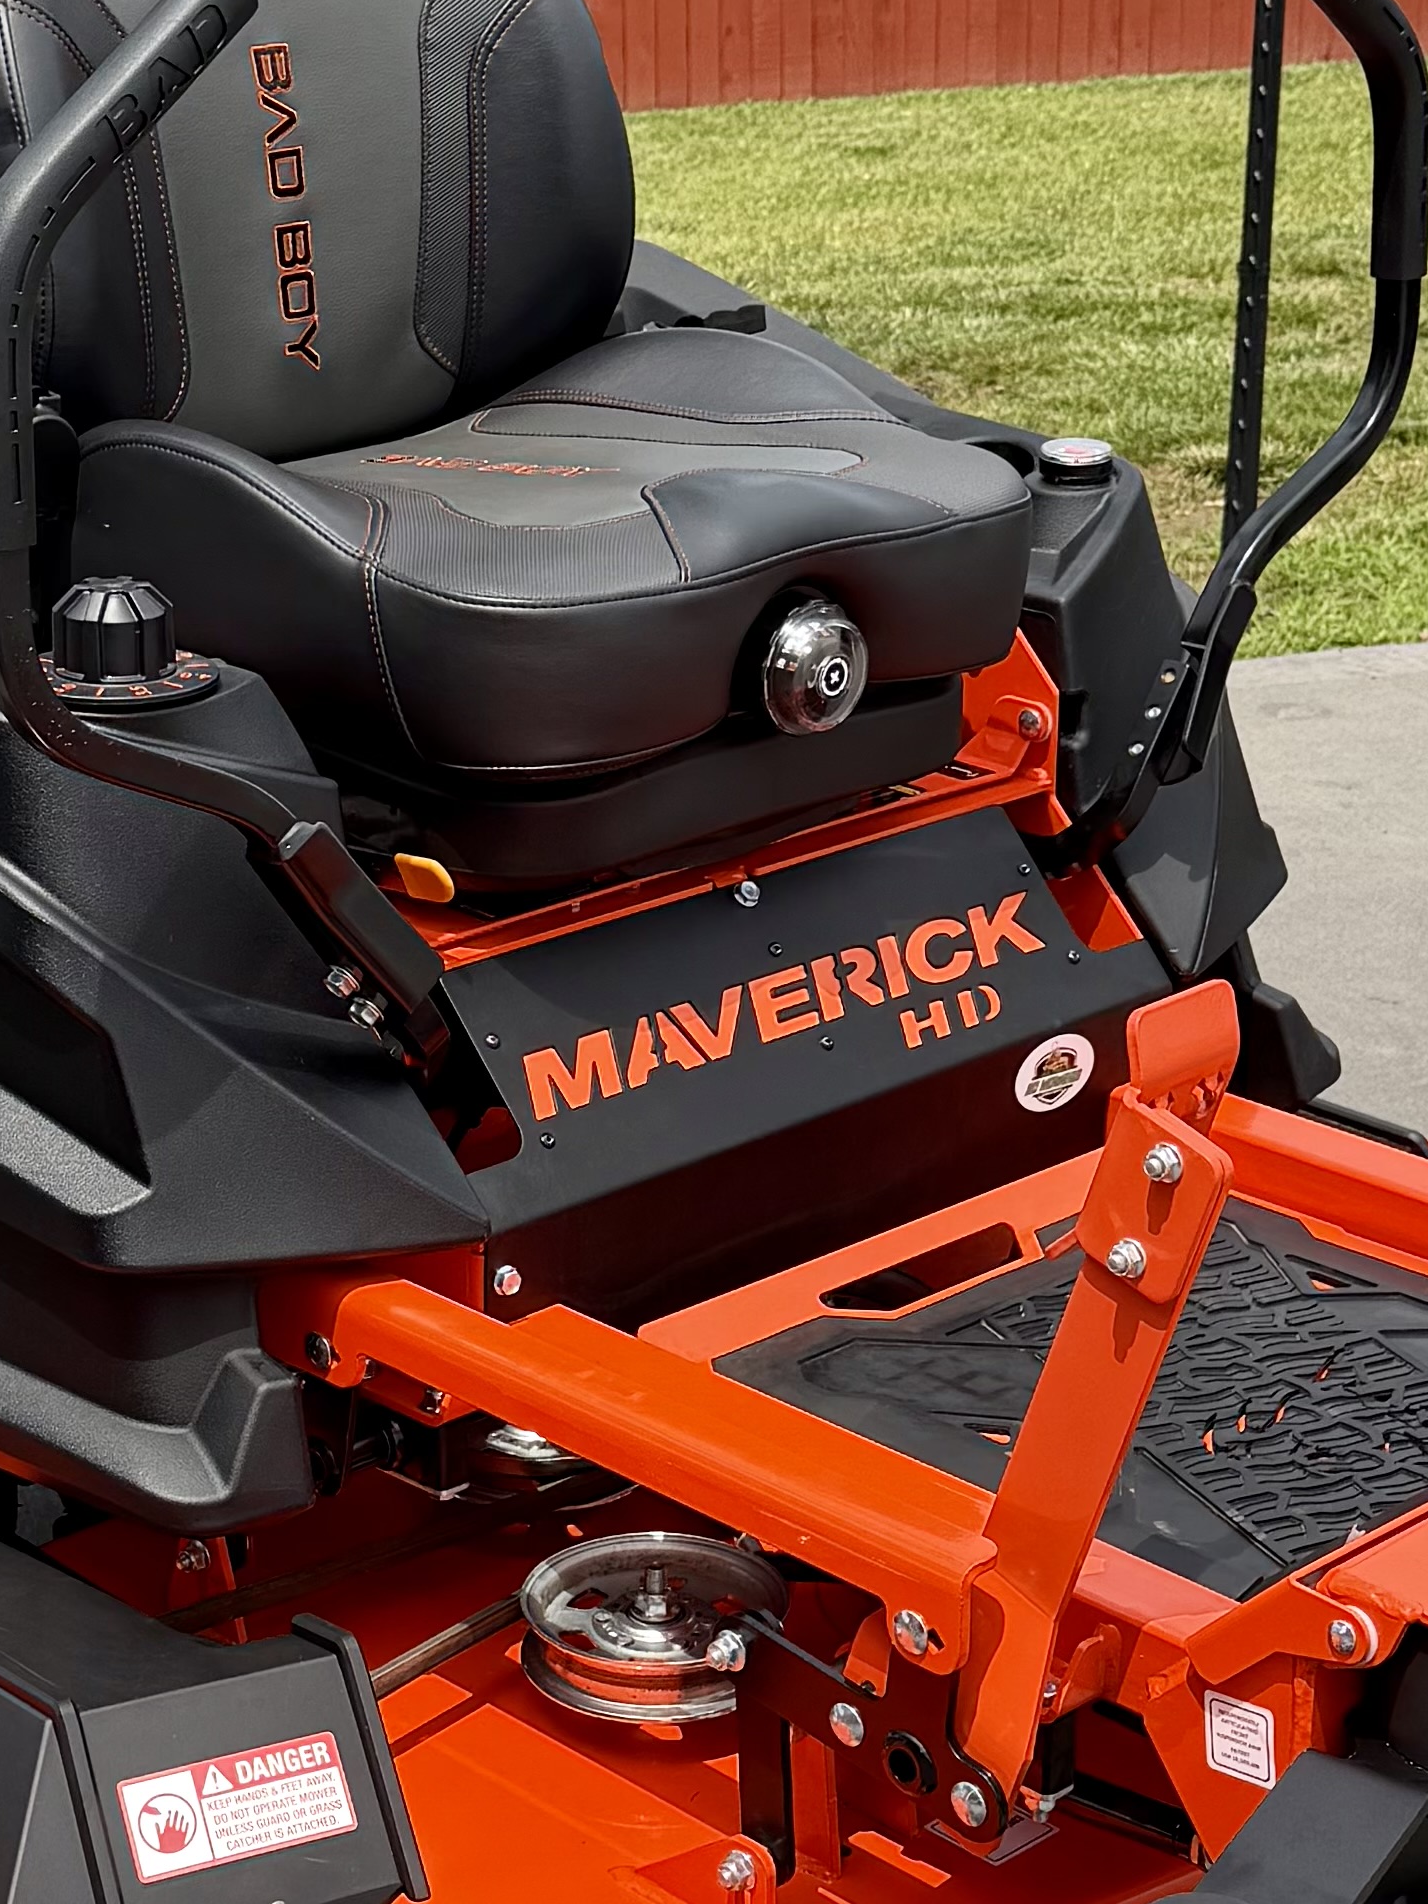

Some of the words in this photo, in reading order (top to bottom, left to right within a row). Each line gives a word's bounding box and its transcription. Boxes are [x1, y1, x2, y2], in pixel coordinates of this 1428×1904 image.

[95, 4, 227, 164] BAD
[249, 42, 306, 203] BAD
[273, 218, 323, 372] BOY
[522, 891, 1047, 1122] MAVERICK
[898, 983, 1004, 1050] HD
[235, 1742, 331, 1784] DANGER
[206, 1798, 232, 1812] KEEP
[233, 1788, 269, 1805] HANDS
[280, 1779, 303, 1793] FEET
[306, 1771, 336, 1787] AWAY.
[213, 1813, 228, 1826] DO
[230, 1807, 250, 1821] NOT
[253, 1796, 298, 1816] OPERATE
[299, 1786, 337, 1804] MOWER
[214, 1821, 254, 1840] UNLESS
[256, 1811, 291, 1829] GUARD
[293, 1807, 308, 1820] OR
[309, 1799, 343, 1816] GRASS
[226, 1831, 273, 1851] CATCHER
[287, 1815, 340, 1836] ATTACHED.
